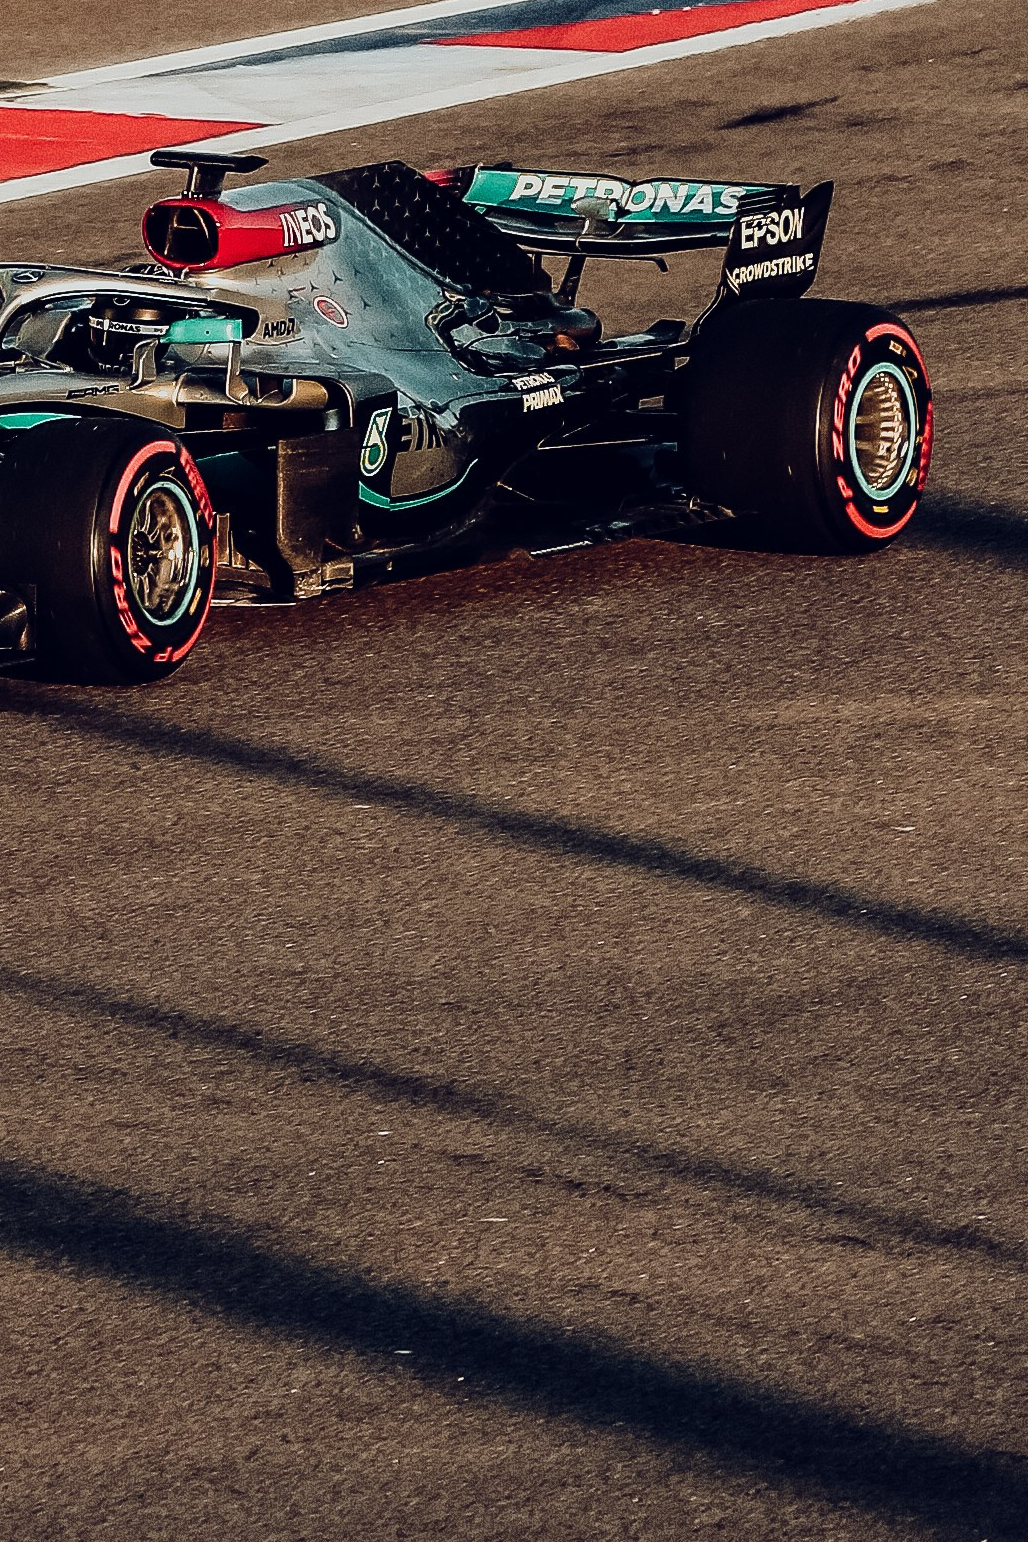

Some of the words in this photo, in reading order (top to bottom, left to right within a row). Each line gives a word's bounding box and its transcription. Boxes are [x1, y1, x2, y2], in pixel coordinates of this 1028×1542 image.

[509, 173, 747, 216] PETRONAS
[279, 202, 336, 247] INEOS
[739, 207, 805, 250] EPSON
[732, 253, 815, 284] CROWDSTRIKE
[832, 343, 861, 461] ZERO
